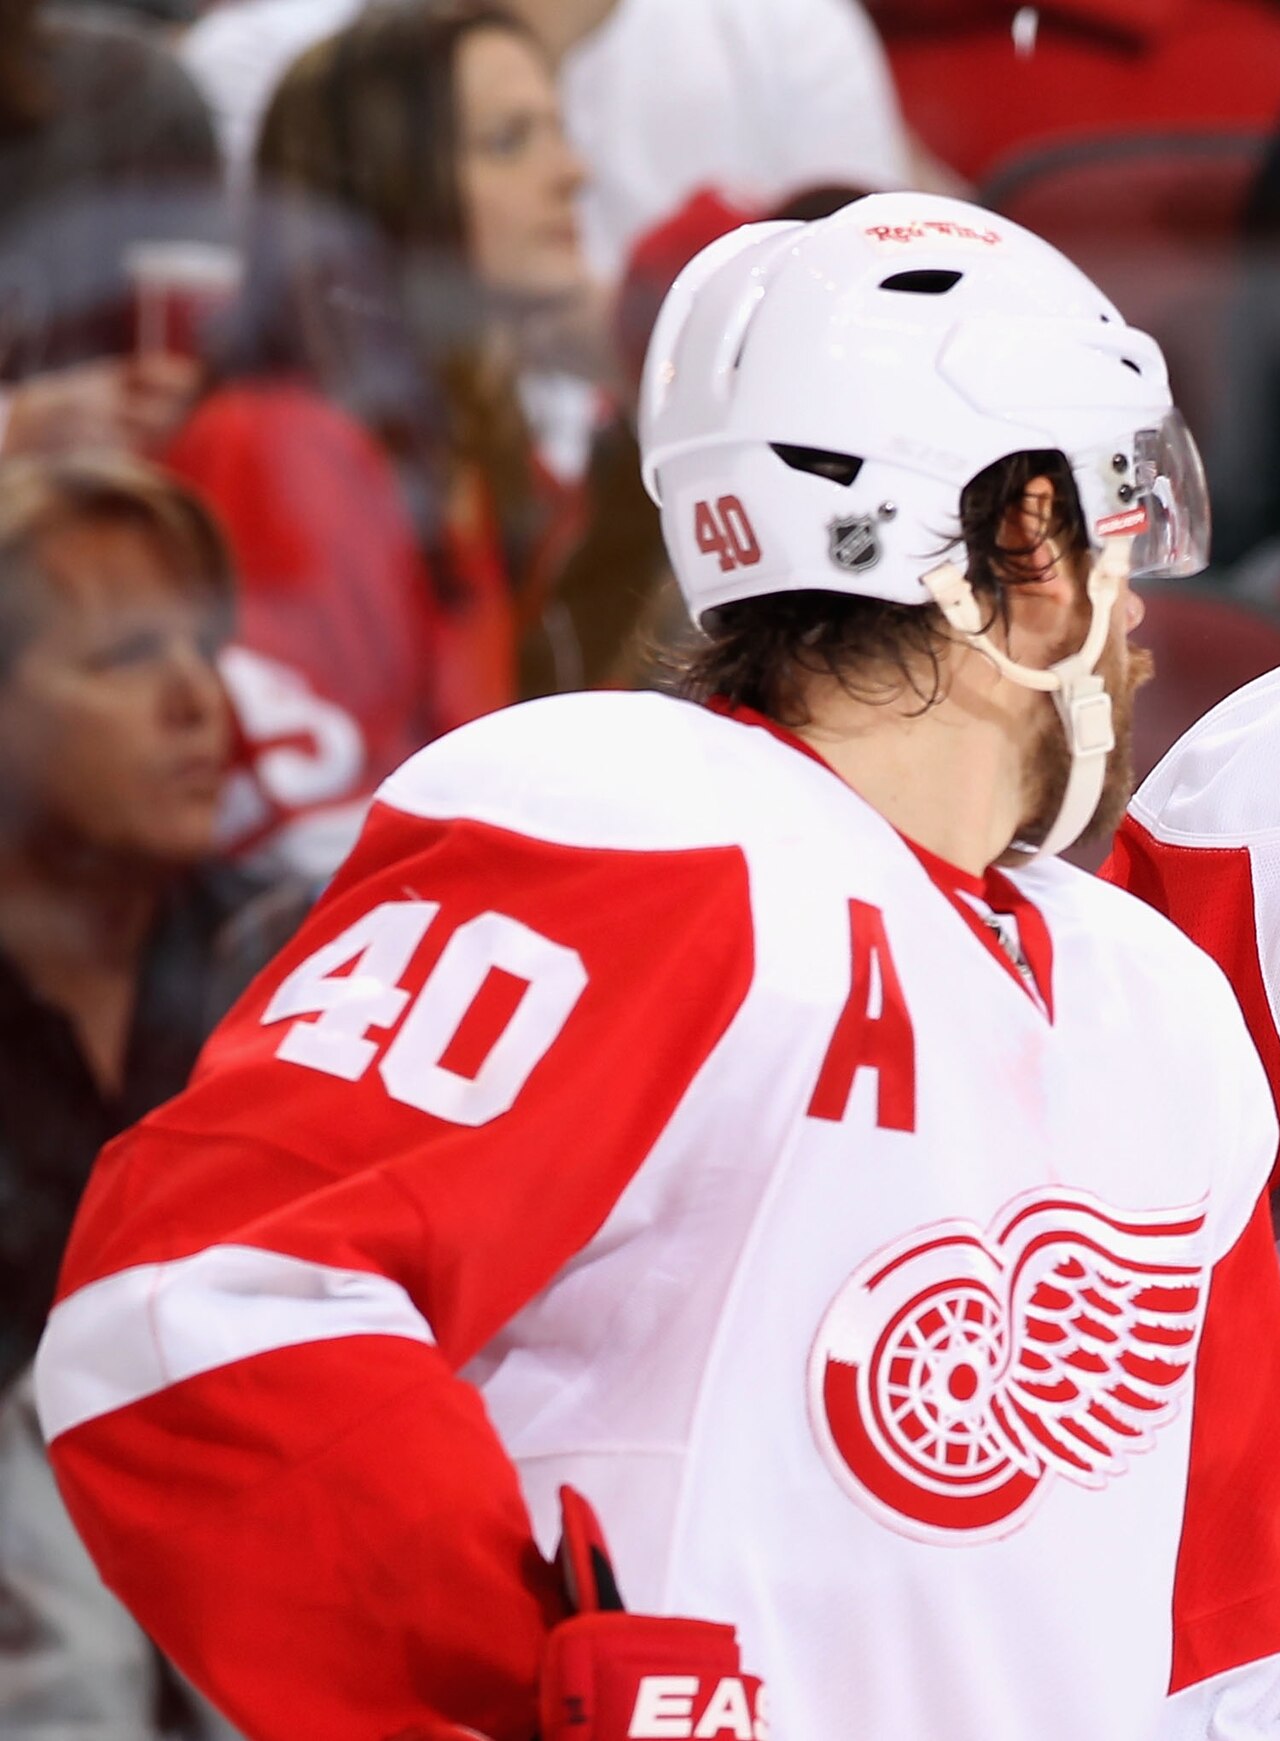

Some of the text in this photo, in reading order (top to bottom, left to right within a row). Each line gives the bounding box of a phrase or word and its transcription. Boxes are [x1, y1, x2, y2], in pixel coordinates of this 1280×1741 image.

[693, 495, 761, 572] 40
[262, 899, 588, 1127] 40
[807, 897, 916, 1133] A
[627, 1675, 768, 1741] EA
